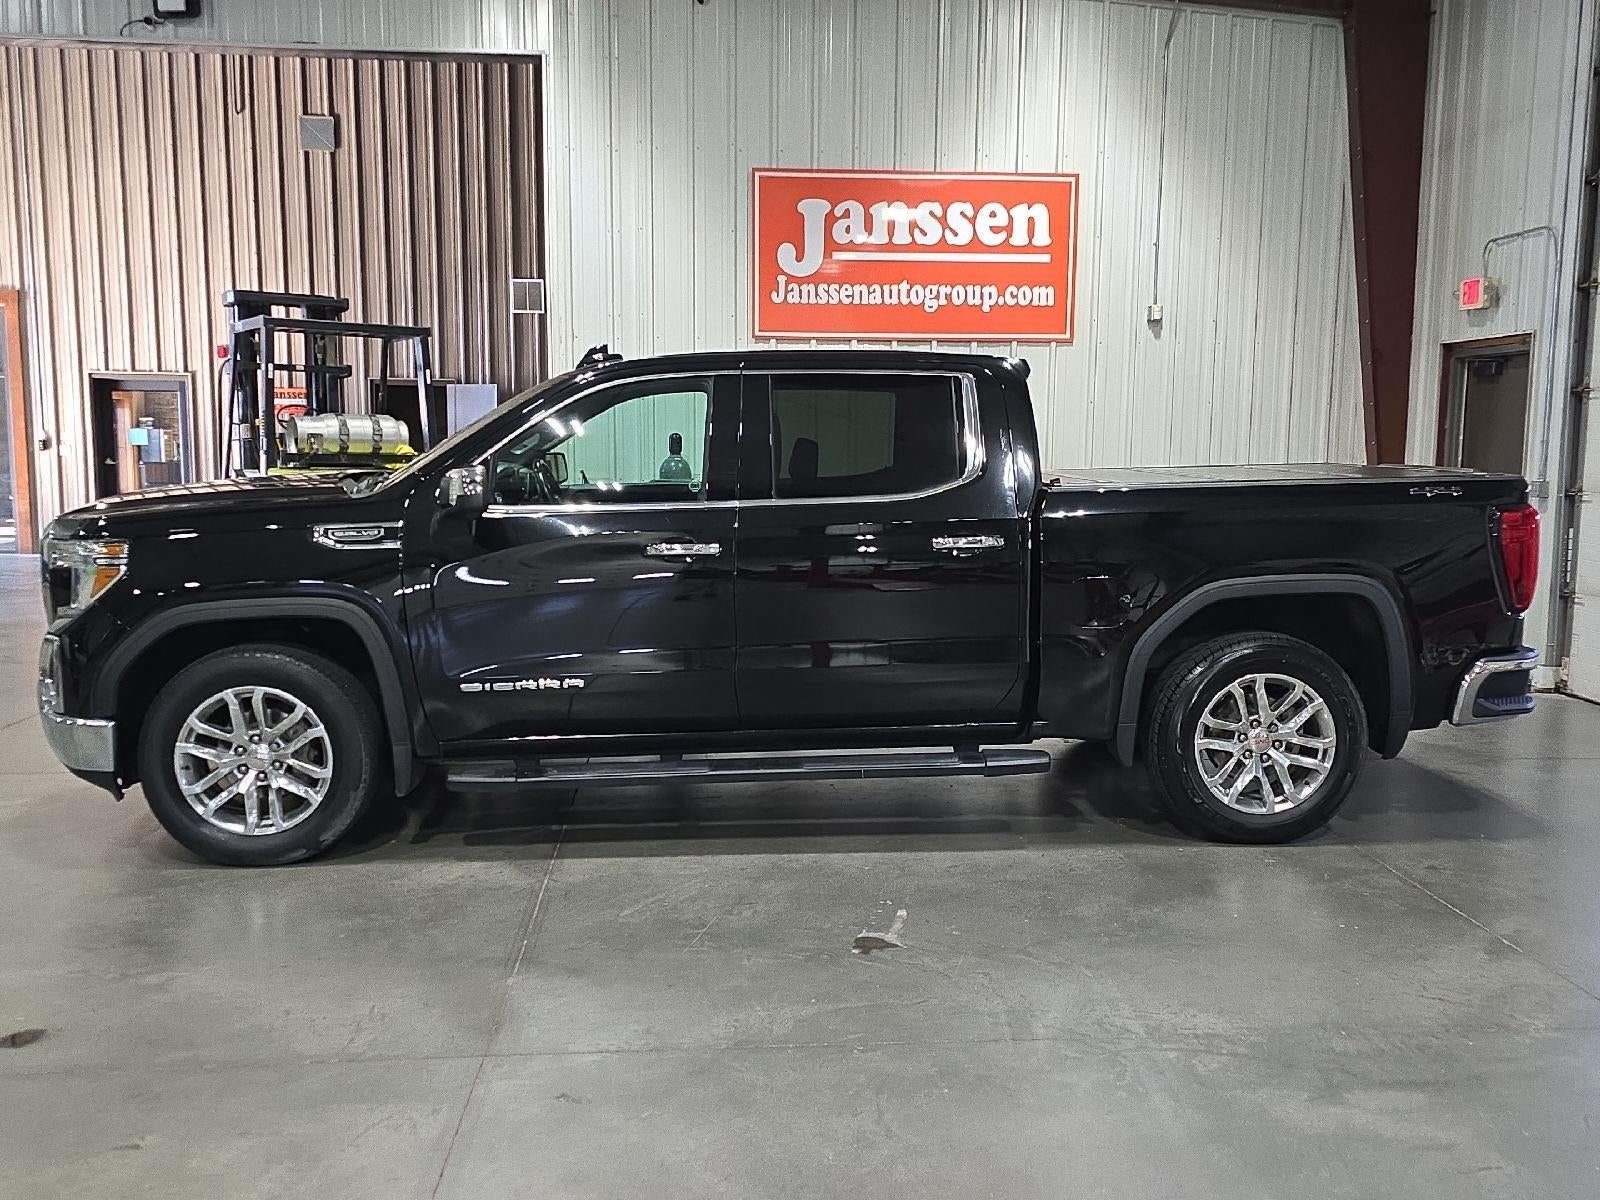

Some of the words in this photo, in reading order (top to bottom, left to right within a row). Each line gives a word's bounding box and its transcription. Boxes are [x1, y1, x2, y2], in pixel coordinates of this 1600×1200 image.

[777, 199, 1053, 278] Janssen
[771, 275, 1056, 313] Janssenautogroup.com
[273, 391, 307, 399] ansse
[459, 678, 585, 692] SIERRA
